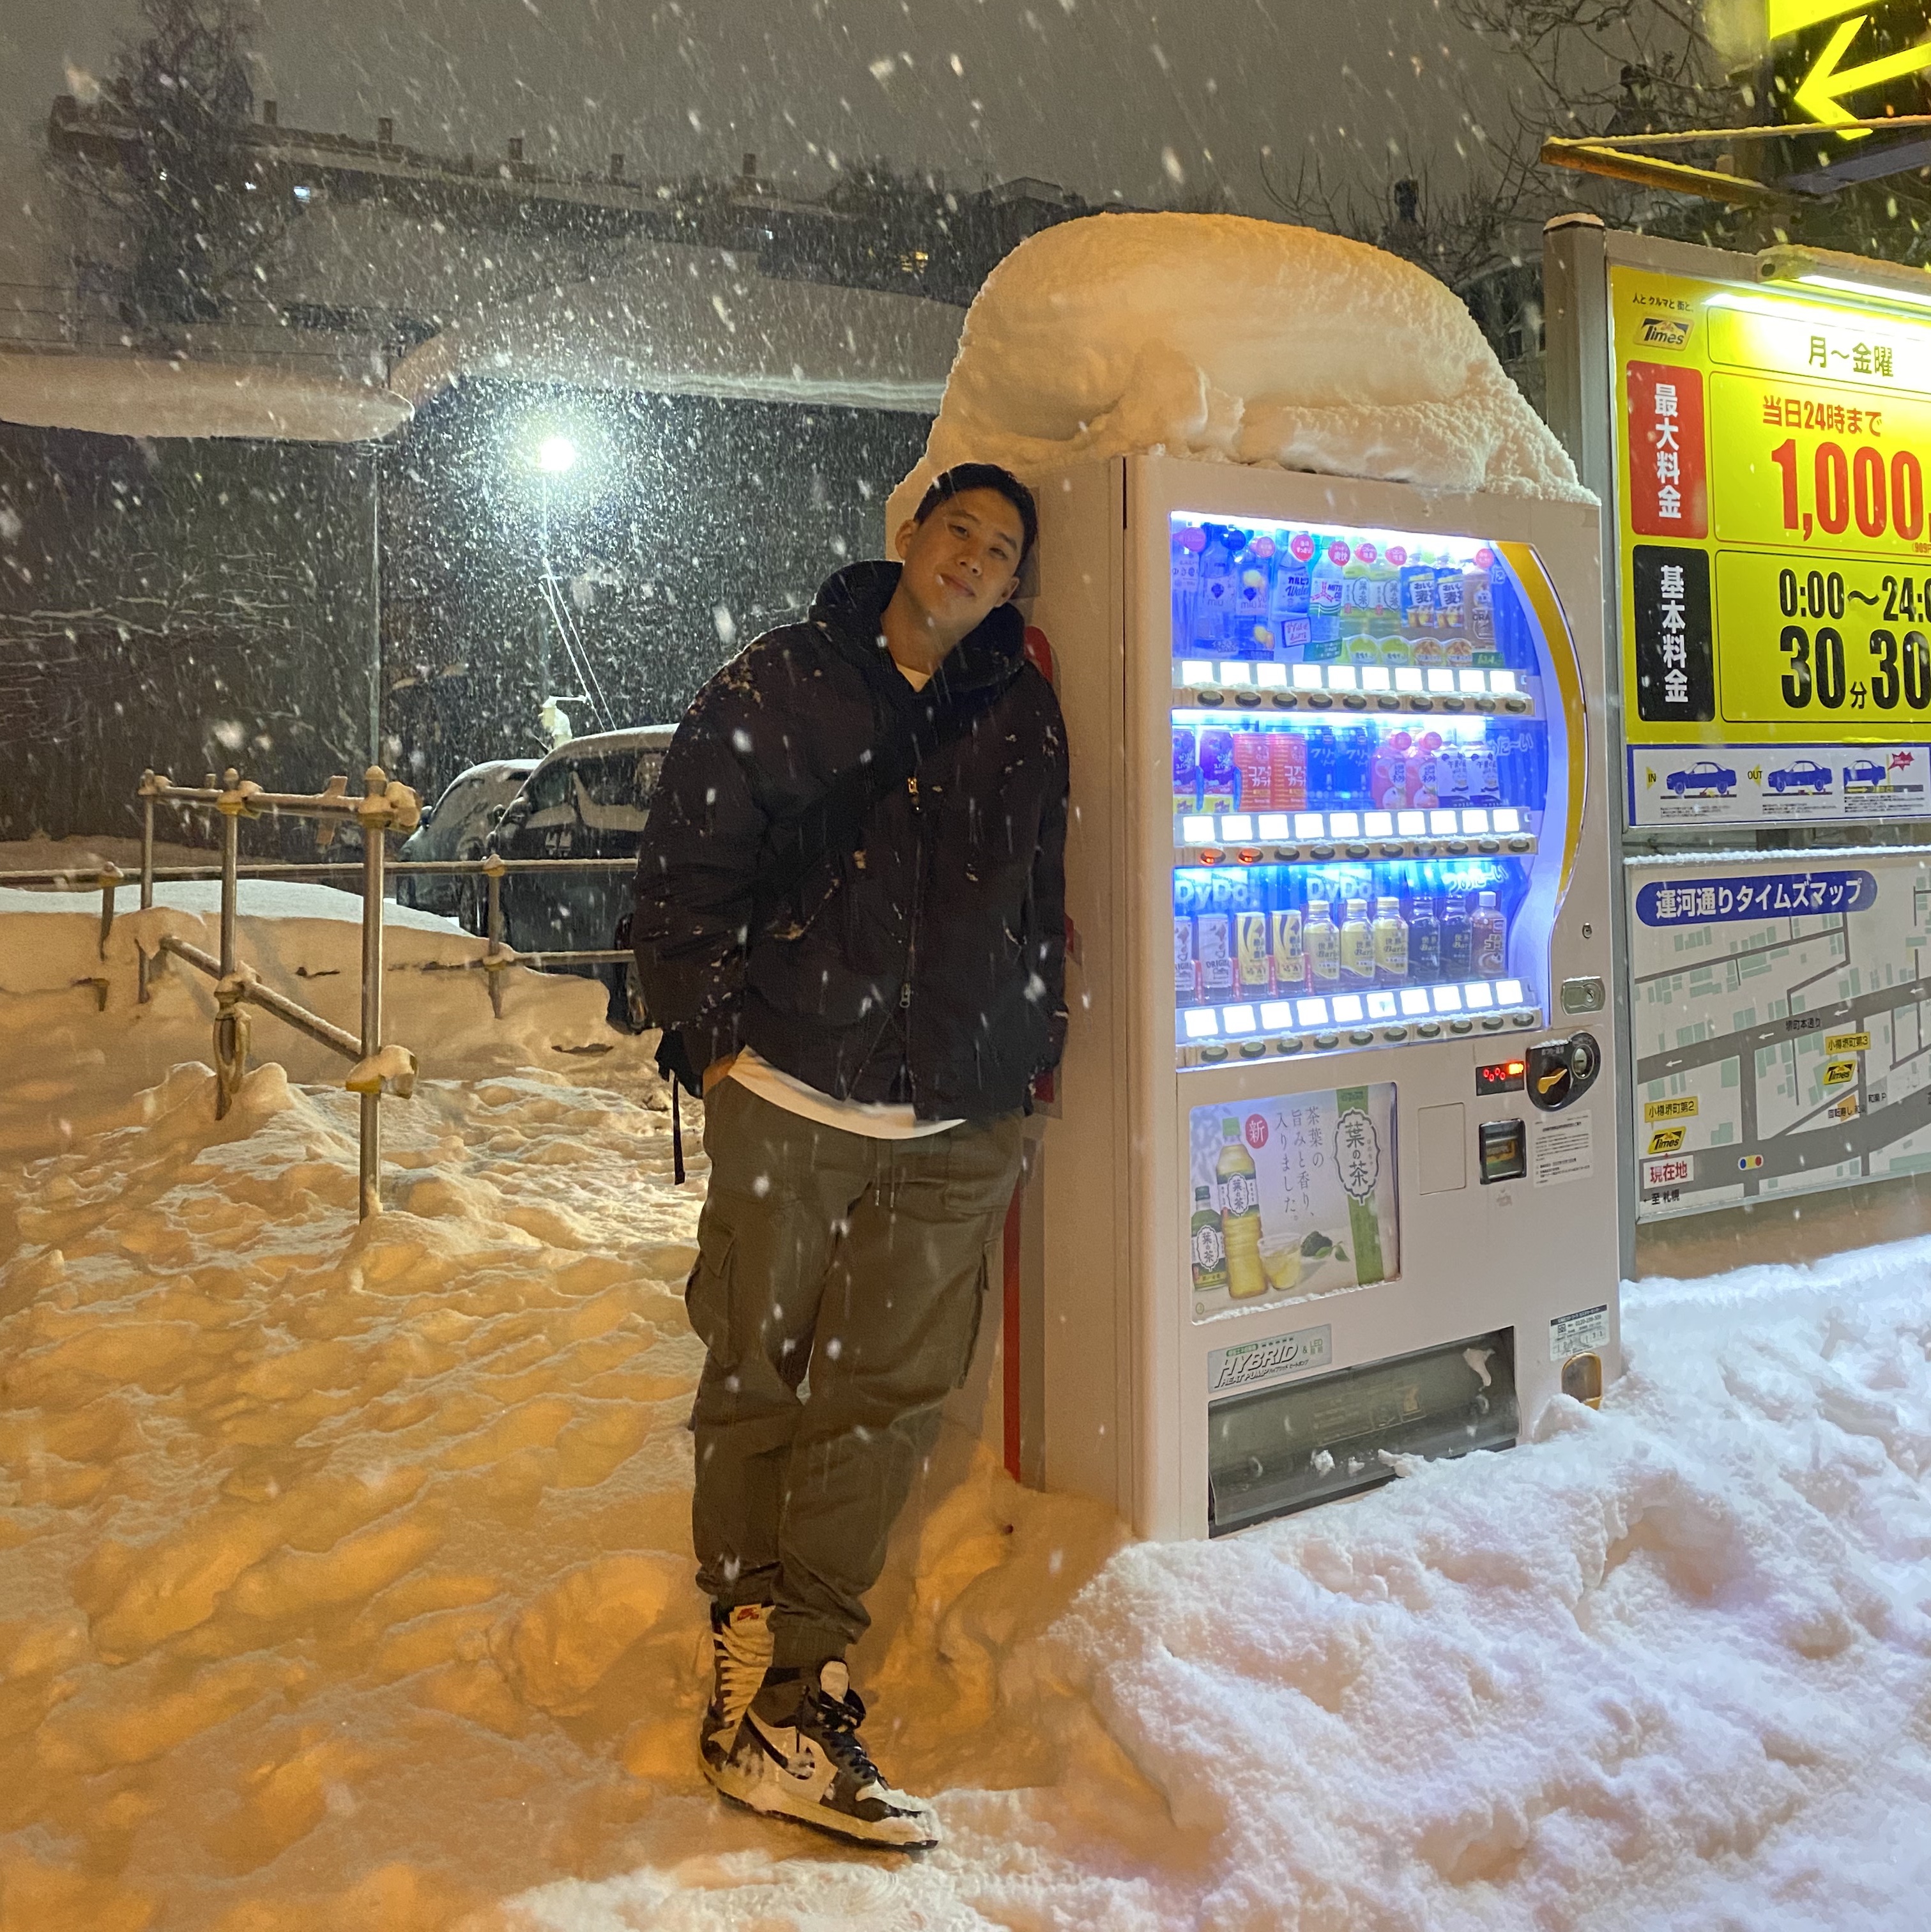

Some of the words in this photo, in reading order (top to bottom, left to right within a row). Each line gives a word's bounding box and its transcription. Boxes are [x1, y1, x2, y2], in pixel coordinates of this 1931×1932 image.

[1644, 326, 1684, 344] Times
[1763, 395, 1882, 437] 当日24時まで
[1654, 383, 1682, 519] 最大料金
[1771, 438, 1931, 542] 1,000
[1661, 565, 1688, 703] 基本料金
[1648, 773, 1656, 783] IN
[1748, 770, 1762, 779] OUT
[1656, 877, 1862, 919] 運河通りタイムズマップ
[1249, 1120, 1265, 1143] 新
[1305, 1106, 1324, 1168] 茶葉の
[1654, 1138, 1679, 1151] Times
[1276, 1112, 1298, 1220] 入りました。
[1292, 1109, 1314, 1216] 旨みと香り、
[1345, 1121, 1368, 1187] 葉の茶
[1650, 1160, 1688, 1183] 現在地
[1232, 1179, 1245, 1210] 葉の茶
[1202, 1231, 1214, 1263] 葉の茶
[1310, 1338, 1322, 1347] LED
[1214, 1344, 1299, 1388] HYBRID
[1221, 1374, 1246, 1387] HEAT
[1246, 1369, 1269, 1381] PUMP
